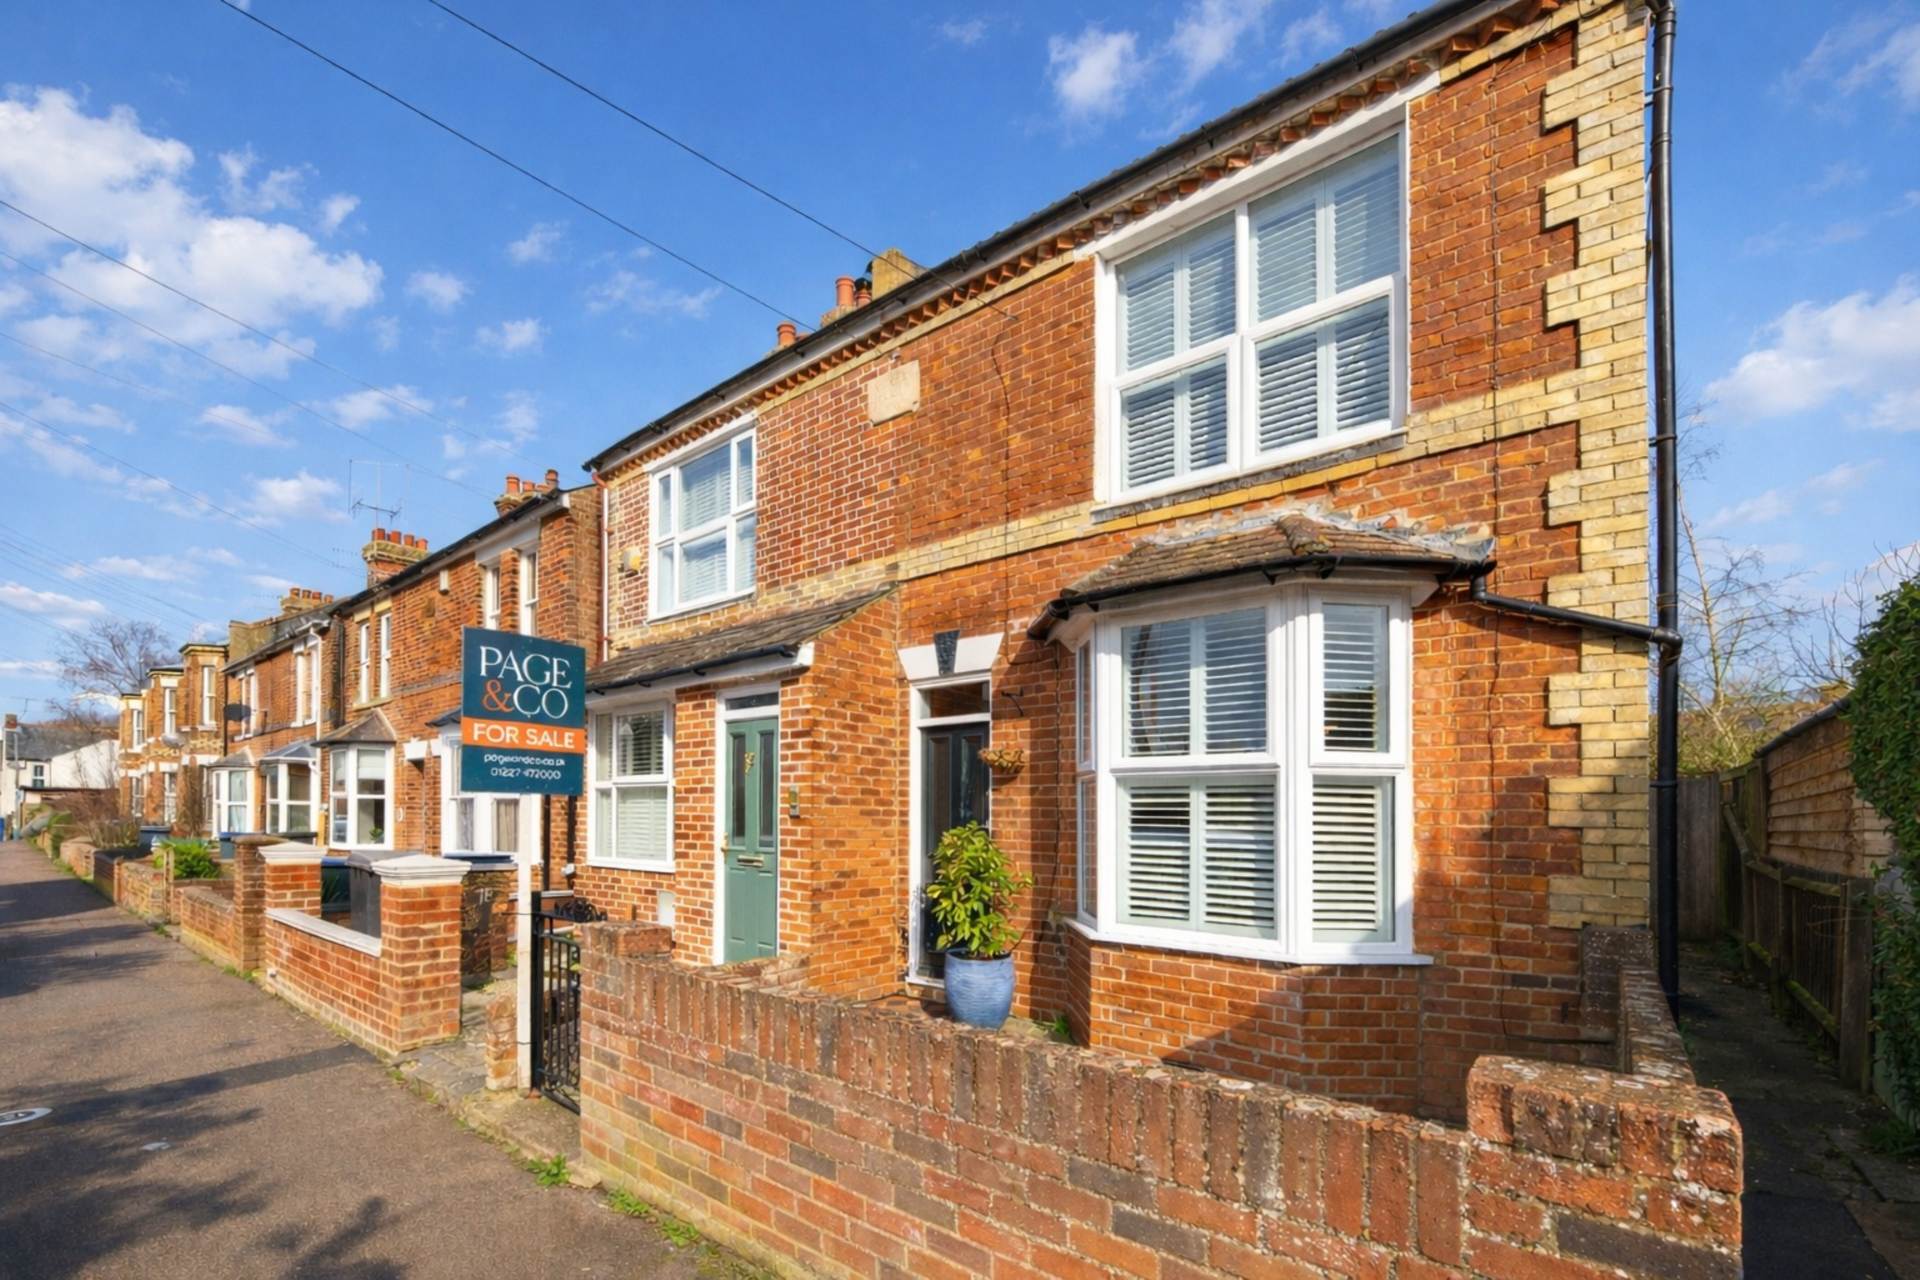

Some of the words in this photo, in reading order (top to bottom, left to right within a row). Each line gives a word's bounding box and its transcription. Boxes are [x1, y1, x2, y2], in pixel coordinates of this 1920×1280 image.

[480, 646, 573, 689] PAGE
[473, 723, 519, 744] FOR
[526, 728, 575, 749] SALE
